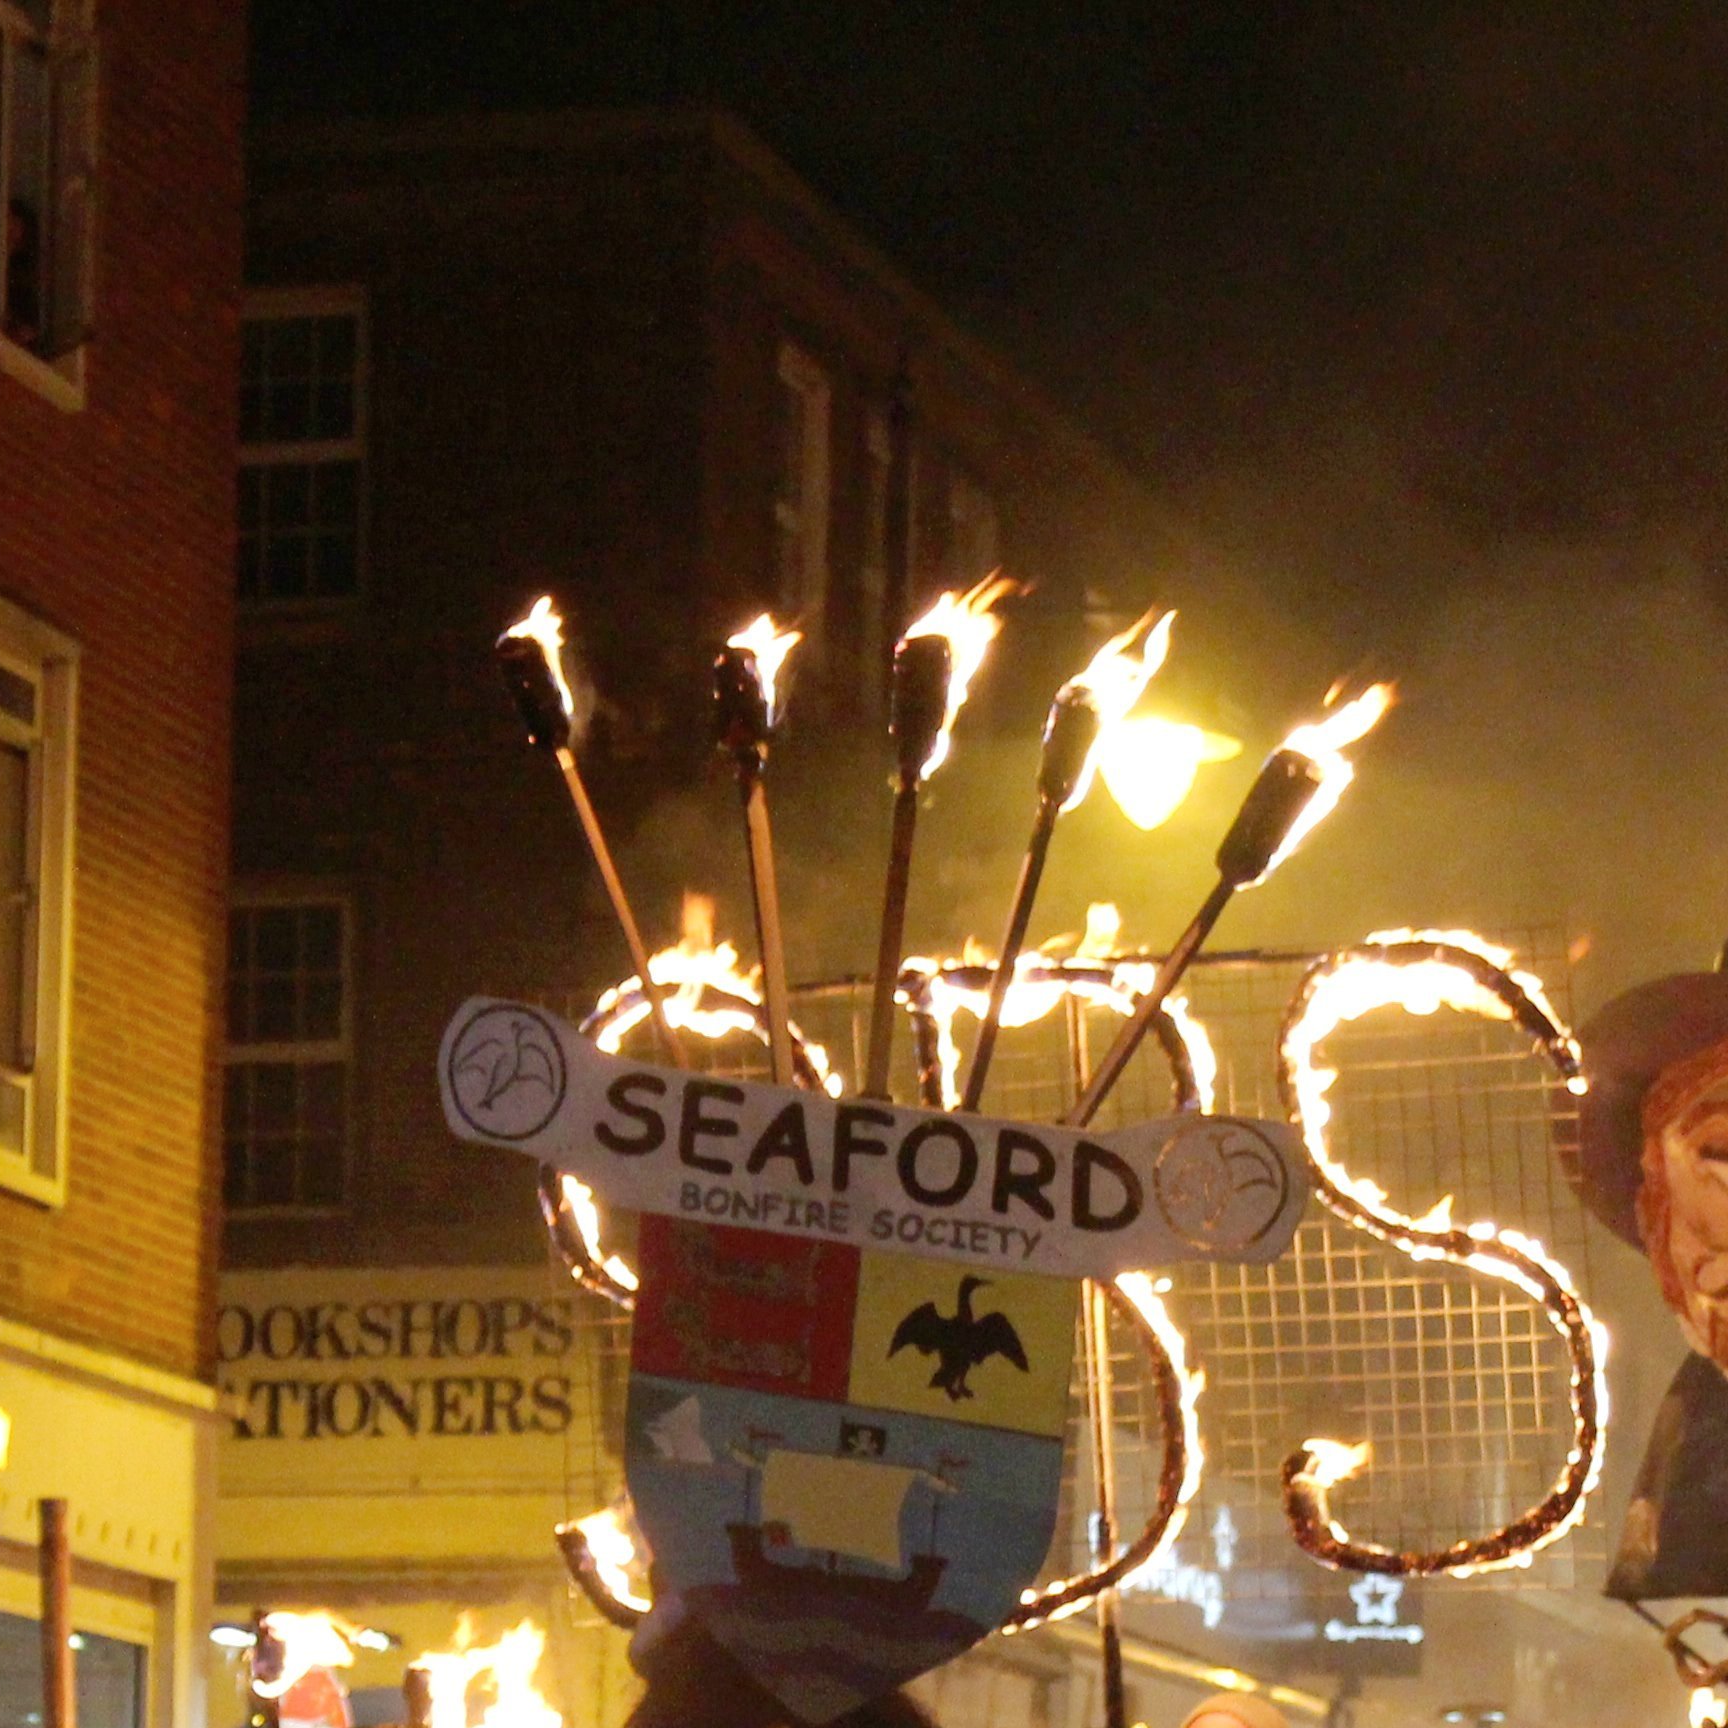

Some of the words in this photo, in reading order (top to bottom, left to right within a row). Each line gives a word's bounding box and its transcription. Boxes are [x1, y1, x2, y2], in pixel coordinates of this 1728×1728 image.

[594, 1072, 1144, 1233] SEAFORD
[679, 1180, 849, 1235] BONFIRE
[870, 1207, 1043, 1260] SOCIETY
